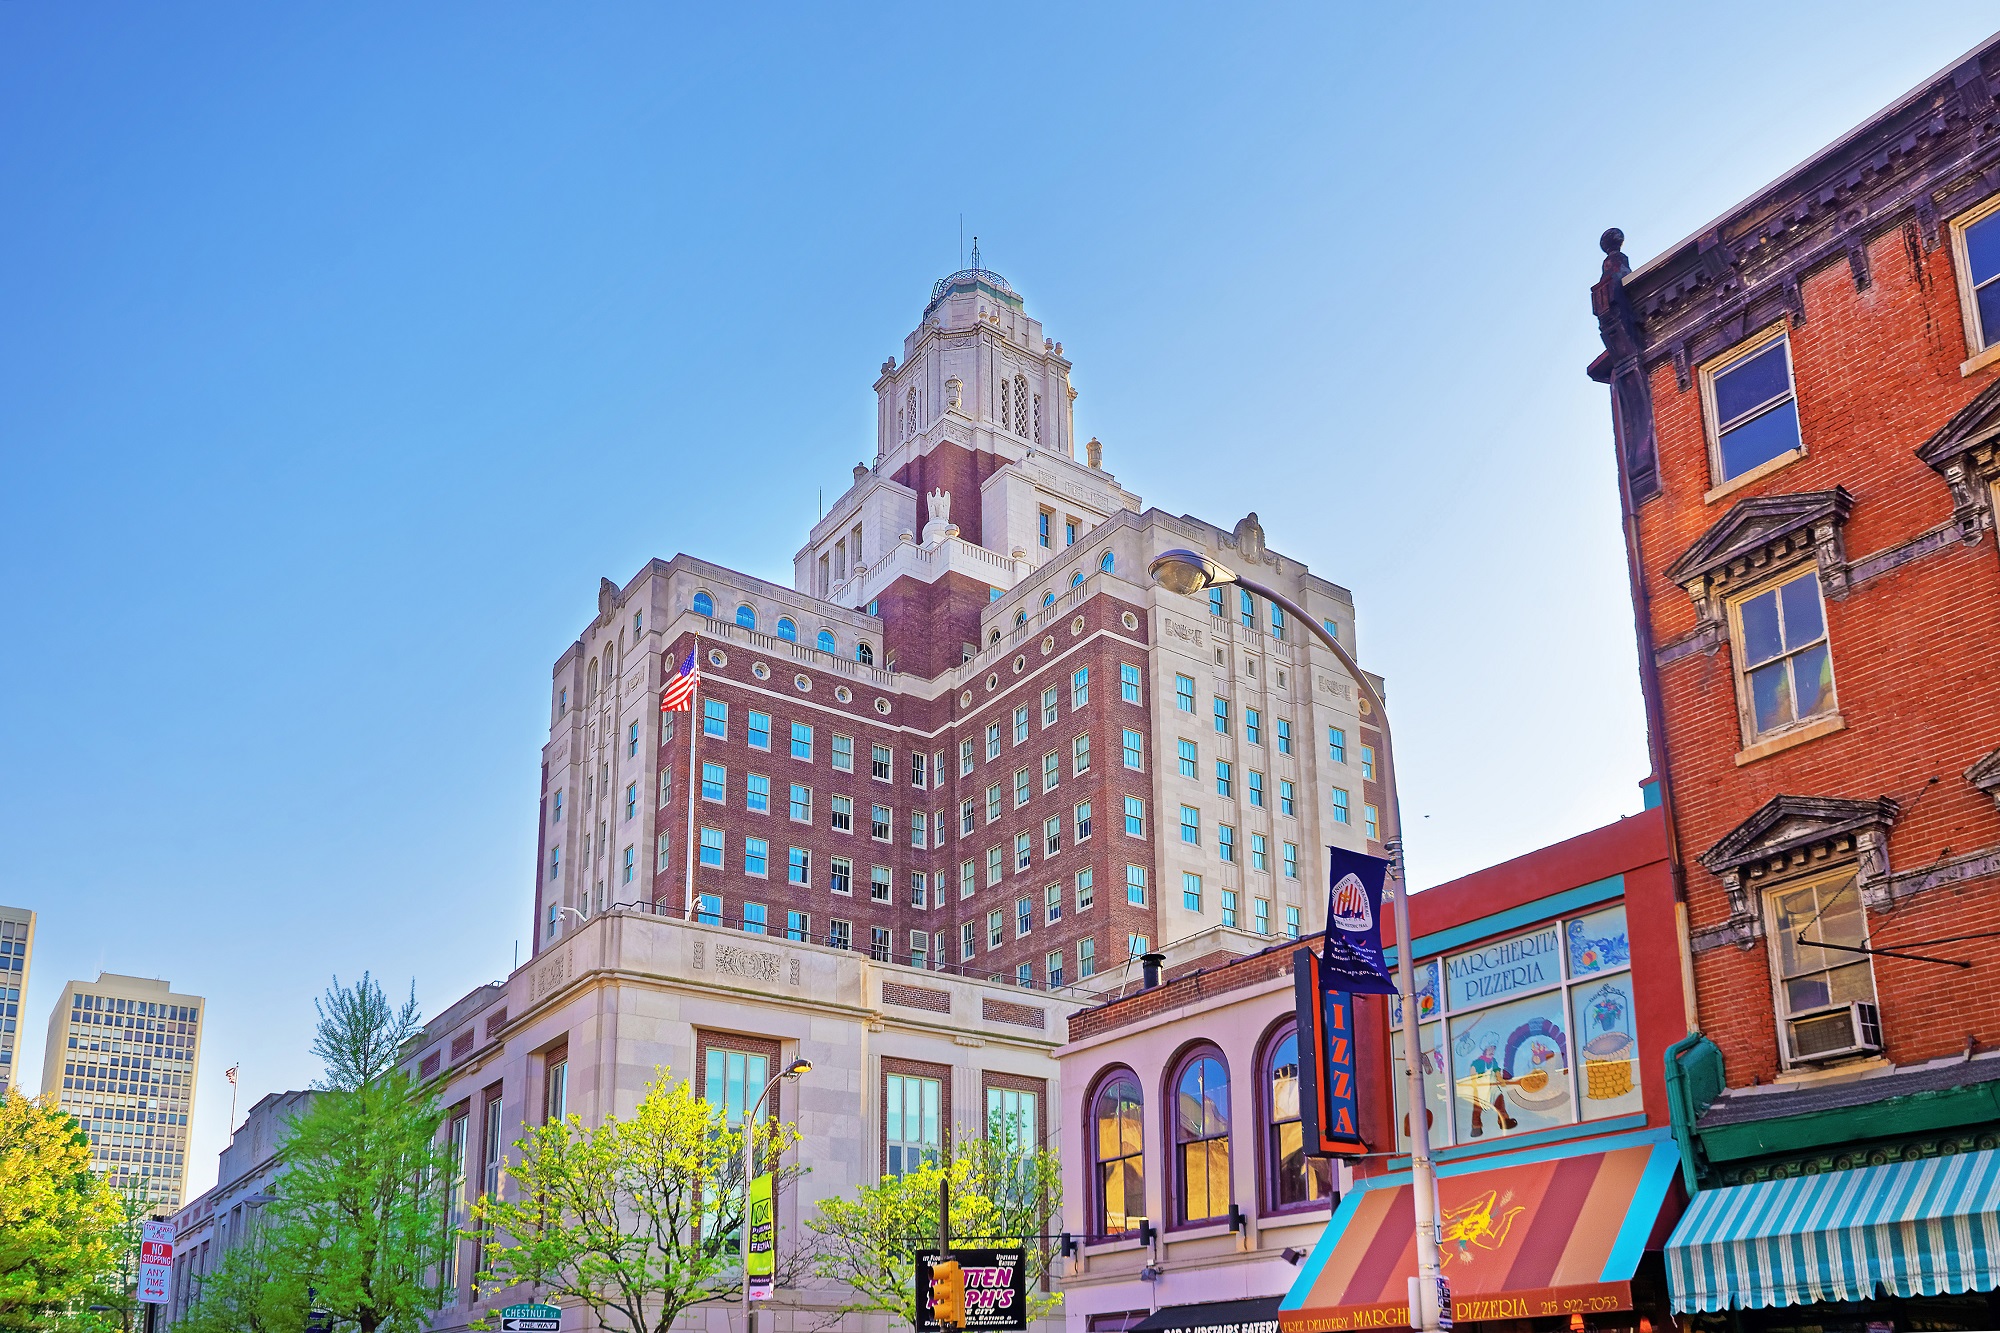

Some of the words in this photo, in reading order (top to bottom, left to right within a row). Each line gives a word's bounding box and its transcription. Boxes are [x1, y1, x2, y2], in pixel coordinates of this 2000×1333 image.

[1447, 930, 1559, 980] MARGHERITA
[1465, 961, 1545, 1001] PIZZERIA
[1328, 990, 1356, 1135] IZZA
[151, 1243, 163, 1255] NO
[142, 1254, 171, 1265] STOPPING
[146, 1268, 165, 1277] ANY
[146, 1278, 164, 1287] TIME
[965, 1289, 1015, 1308] PH'S
[505, 1309, 546, 1318] CHESTNUT
[1283, 1321, 1304, 1333] FREE
[1307, 1316, 1348, 1331] DELIVERY
[1353, 1307, 1411, 1328] MARGH
[1456, 1298, 1529, 1320] PIZZERIA
[1540, 1301, 1558, 1314] 215
[1564, 1296, 1619, 1313] 922-7053
[1241, 1320, 1279, 1333] EATERY
